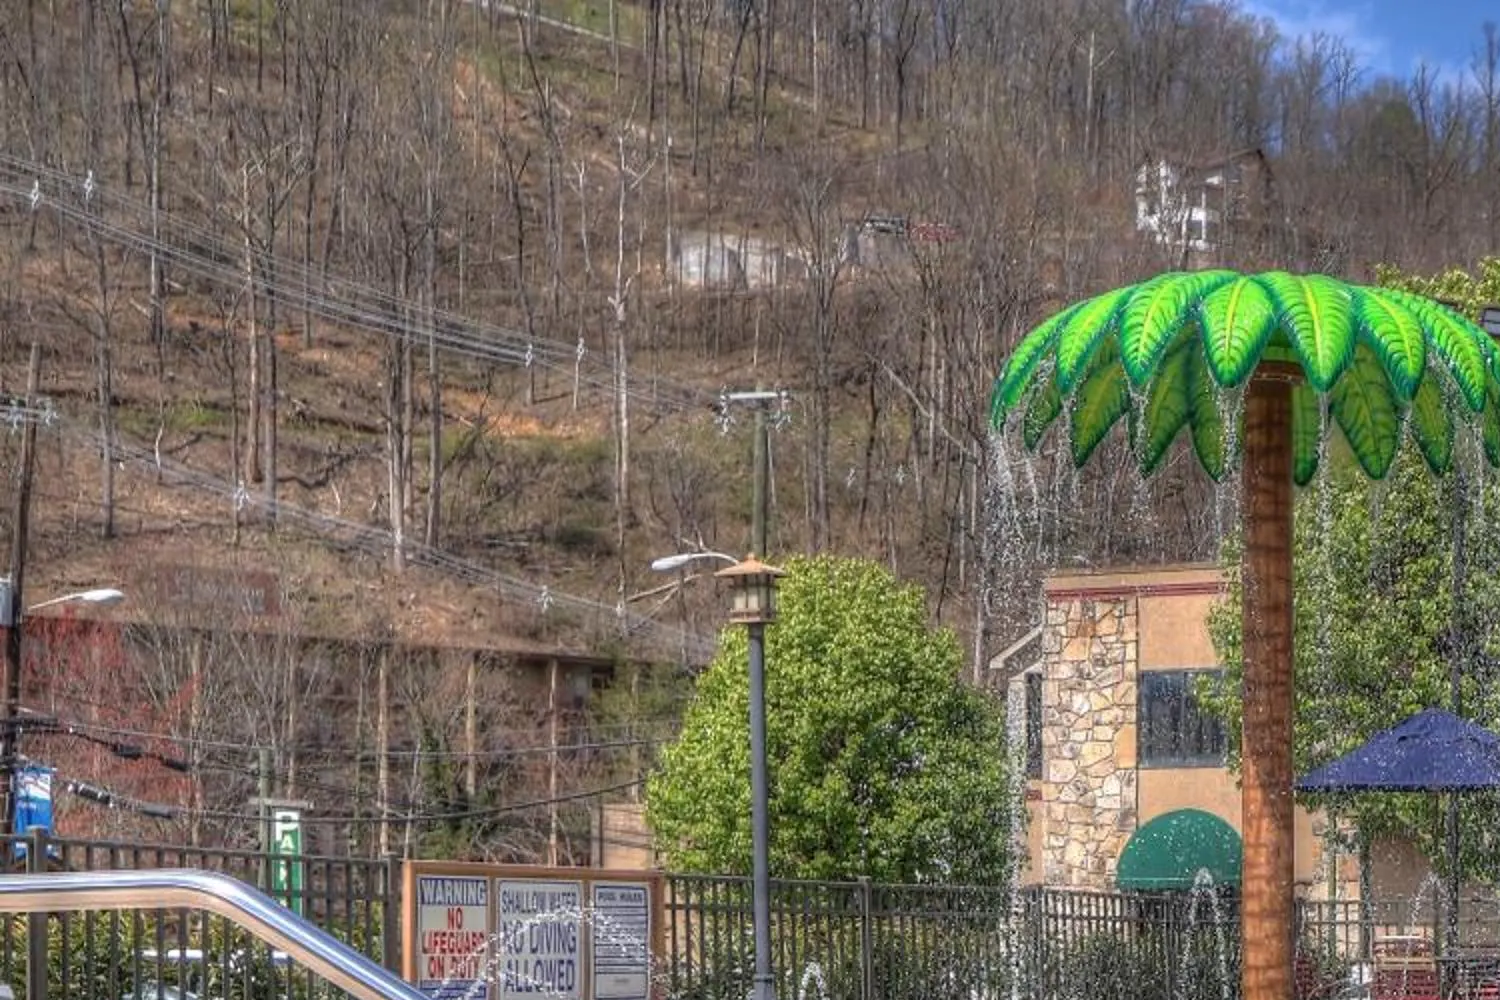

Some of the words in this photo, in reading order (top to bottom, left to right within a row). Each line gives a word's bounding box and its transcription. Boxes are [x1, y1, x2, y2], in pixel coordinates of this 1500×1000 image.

[421, 879, 486, 905] WARNING
[502, 889, 546, 913] SHALLOW
[447, 907, 463, 930] NO
[422, 931, 485, 954] LIFEGUARD
[503, 921, 525, 954] NO
[530, 922, 577, 954] DIVING
[428, 956, 445, 978] ON
[450, 956, 480, 978] DUTY
[503, 959, 576, 992] ALLOWED
